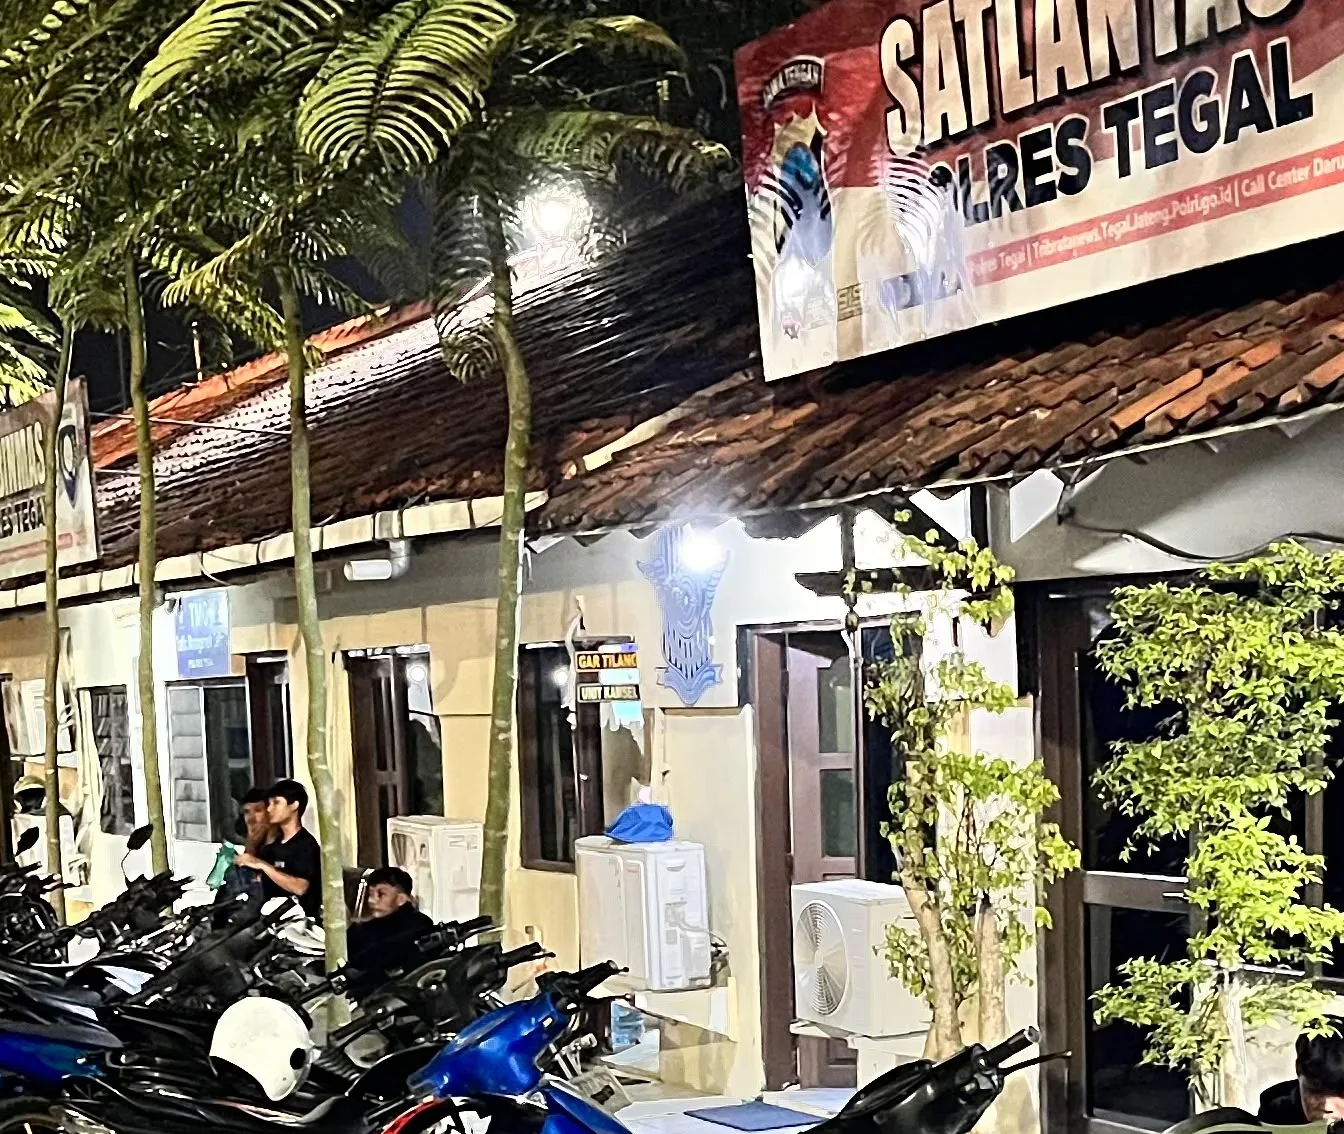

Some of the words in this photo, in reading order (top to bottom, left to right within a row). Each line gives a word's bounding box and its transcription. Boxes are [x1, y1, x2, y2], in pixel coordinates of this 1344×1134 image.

[880, 0, 1294, 156] SATLAN
[929, 115, 1092, 226] LRES
[1103, 39, 1314, 178] TEGAL
[1241, 173, 1265, 197] Call
[1268, 164, 1312, 189] Center
[14, 496, 46, 534] TEGA
[578, 654, 600, 668] GAR
